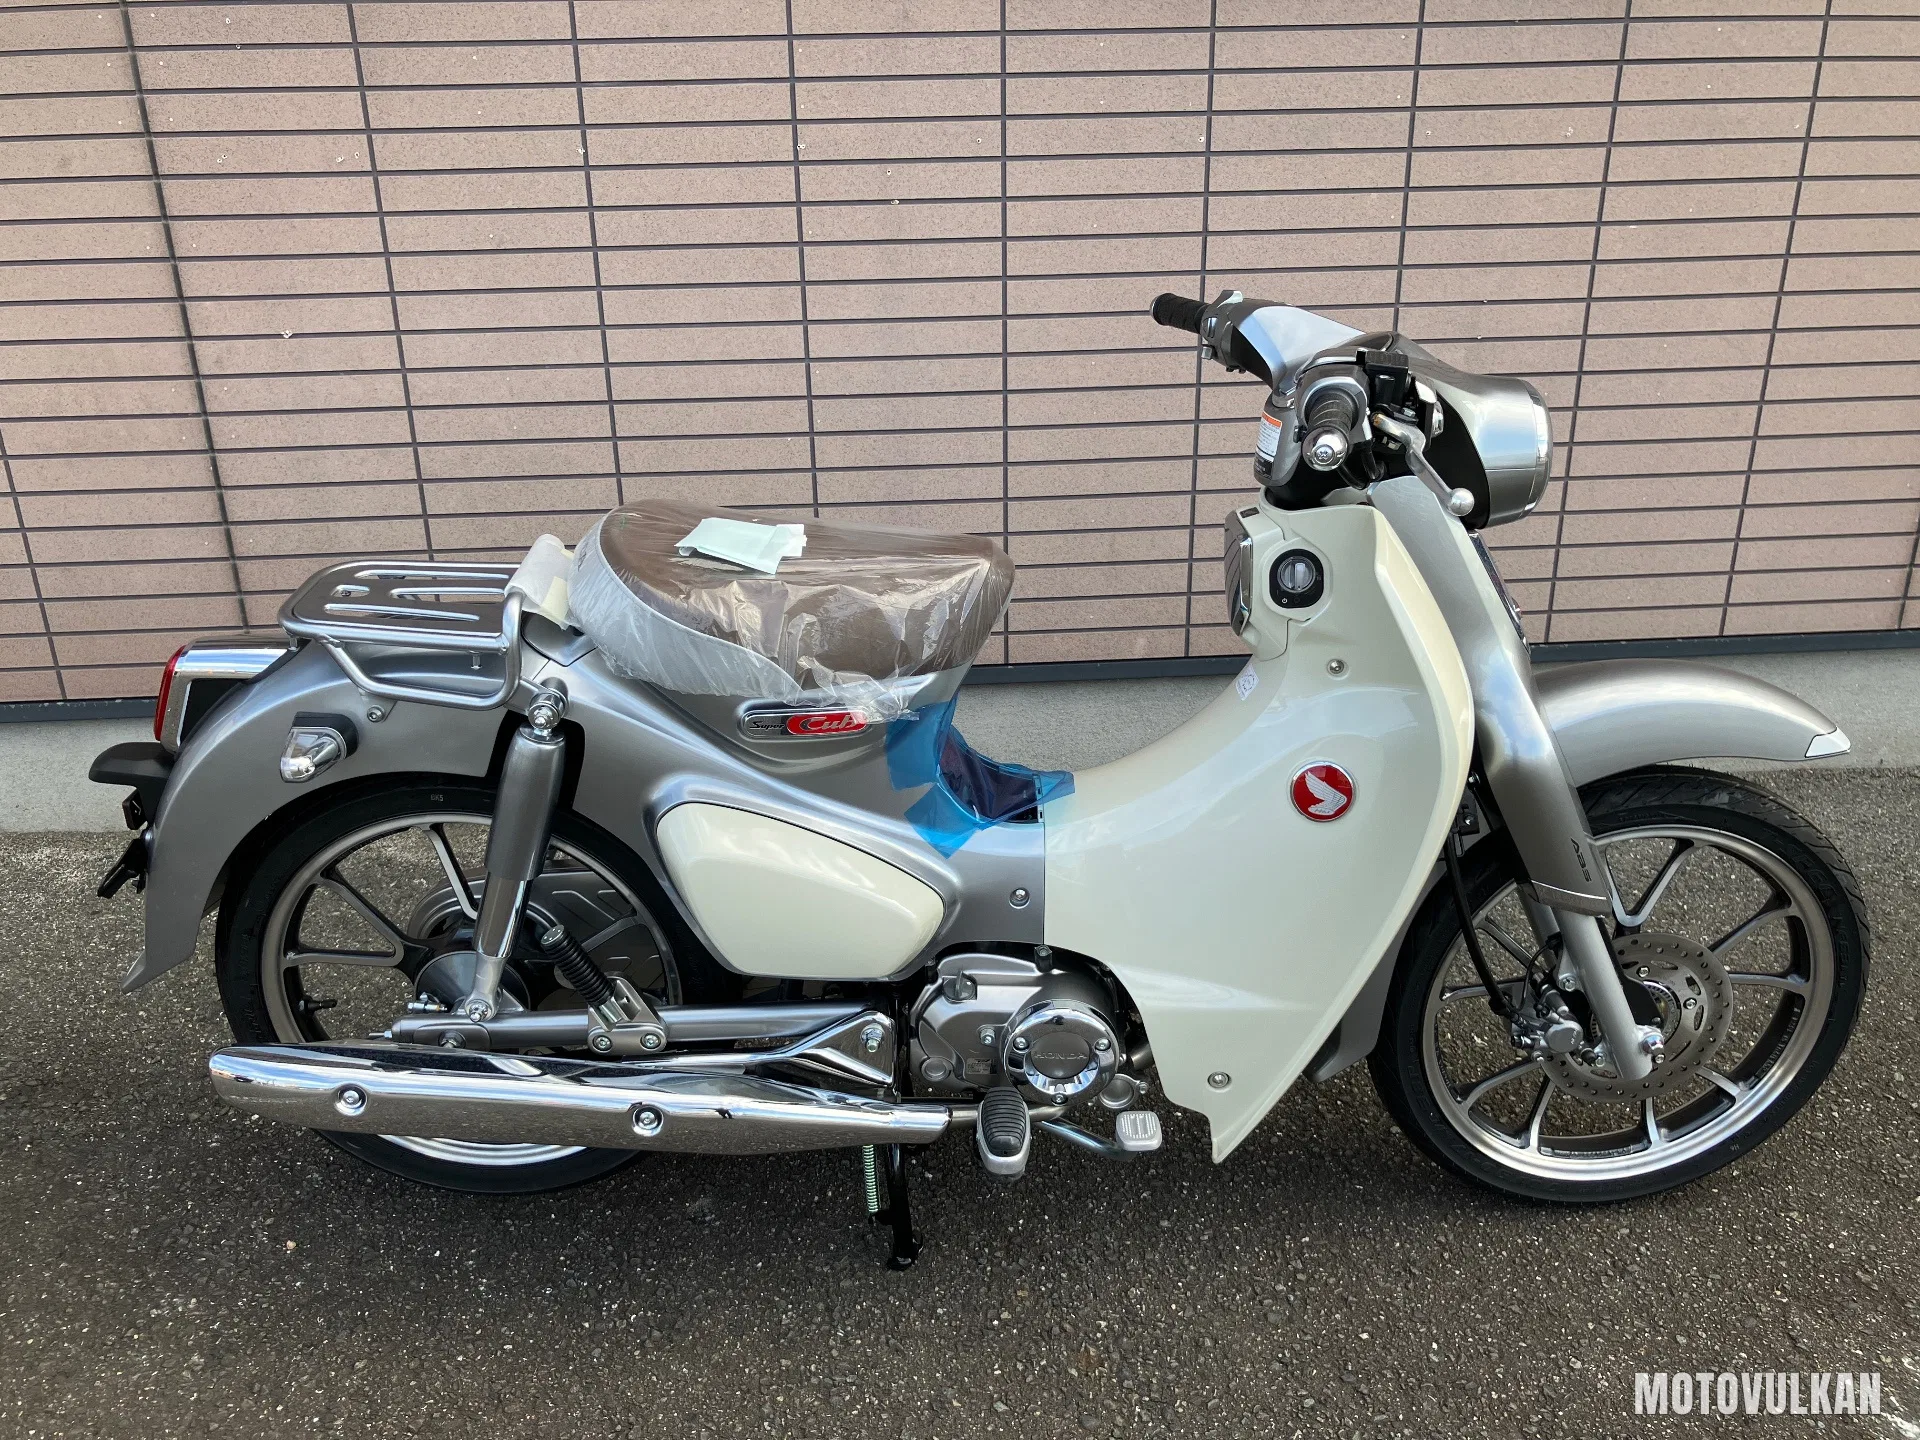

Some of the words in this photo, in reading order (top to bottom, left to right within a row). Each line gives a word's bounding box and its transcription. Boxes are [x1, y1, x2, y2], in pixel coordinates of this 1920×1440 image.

[750, 720, 785, 731] Super
[799, 714, 858, 731] Cub
[1570, 837, 1592, 883] ABS
[1034, 1051, 1088, 1060] HONDA
